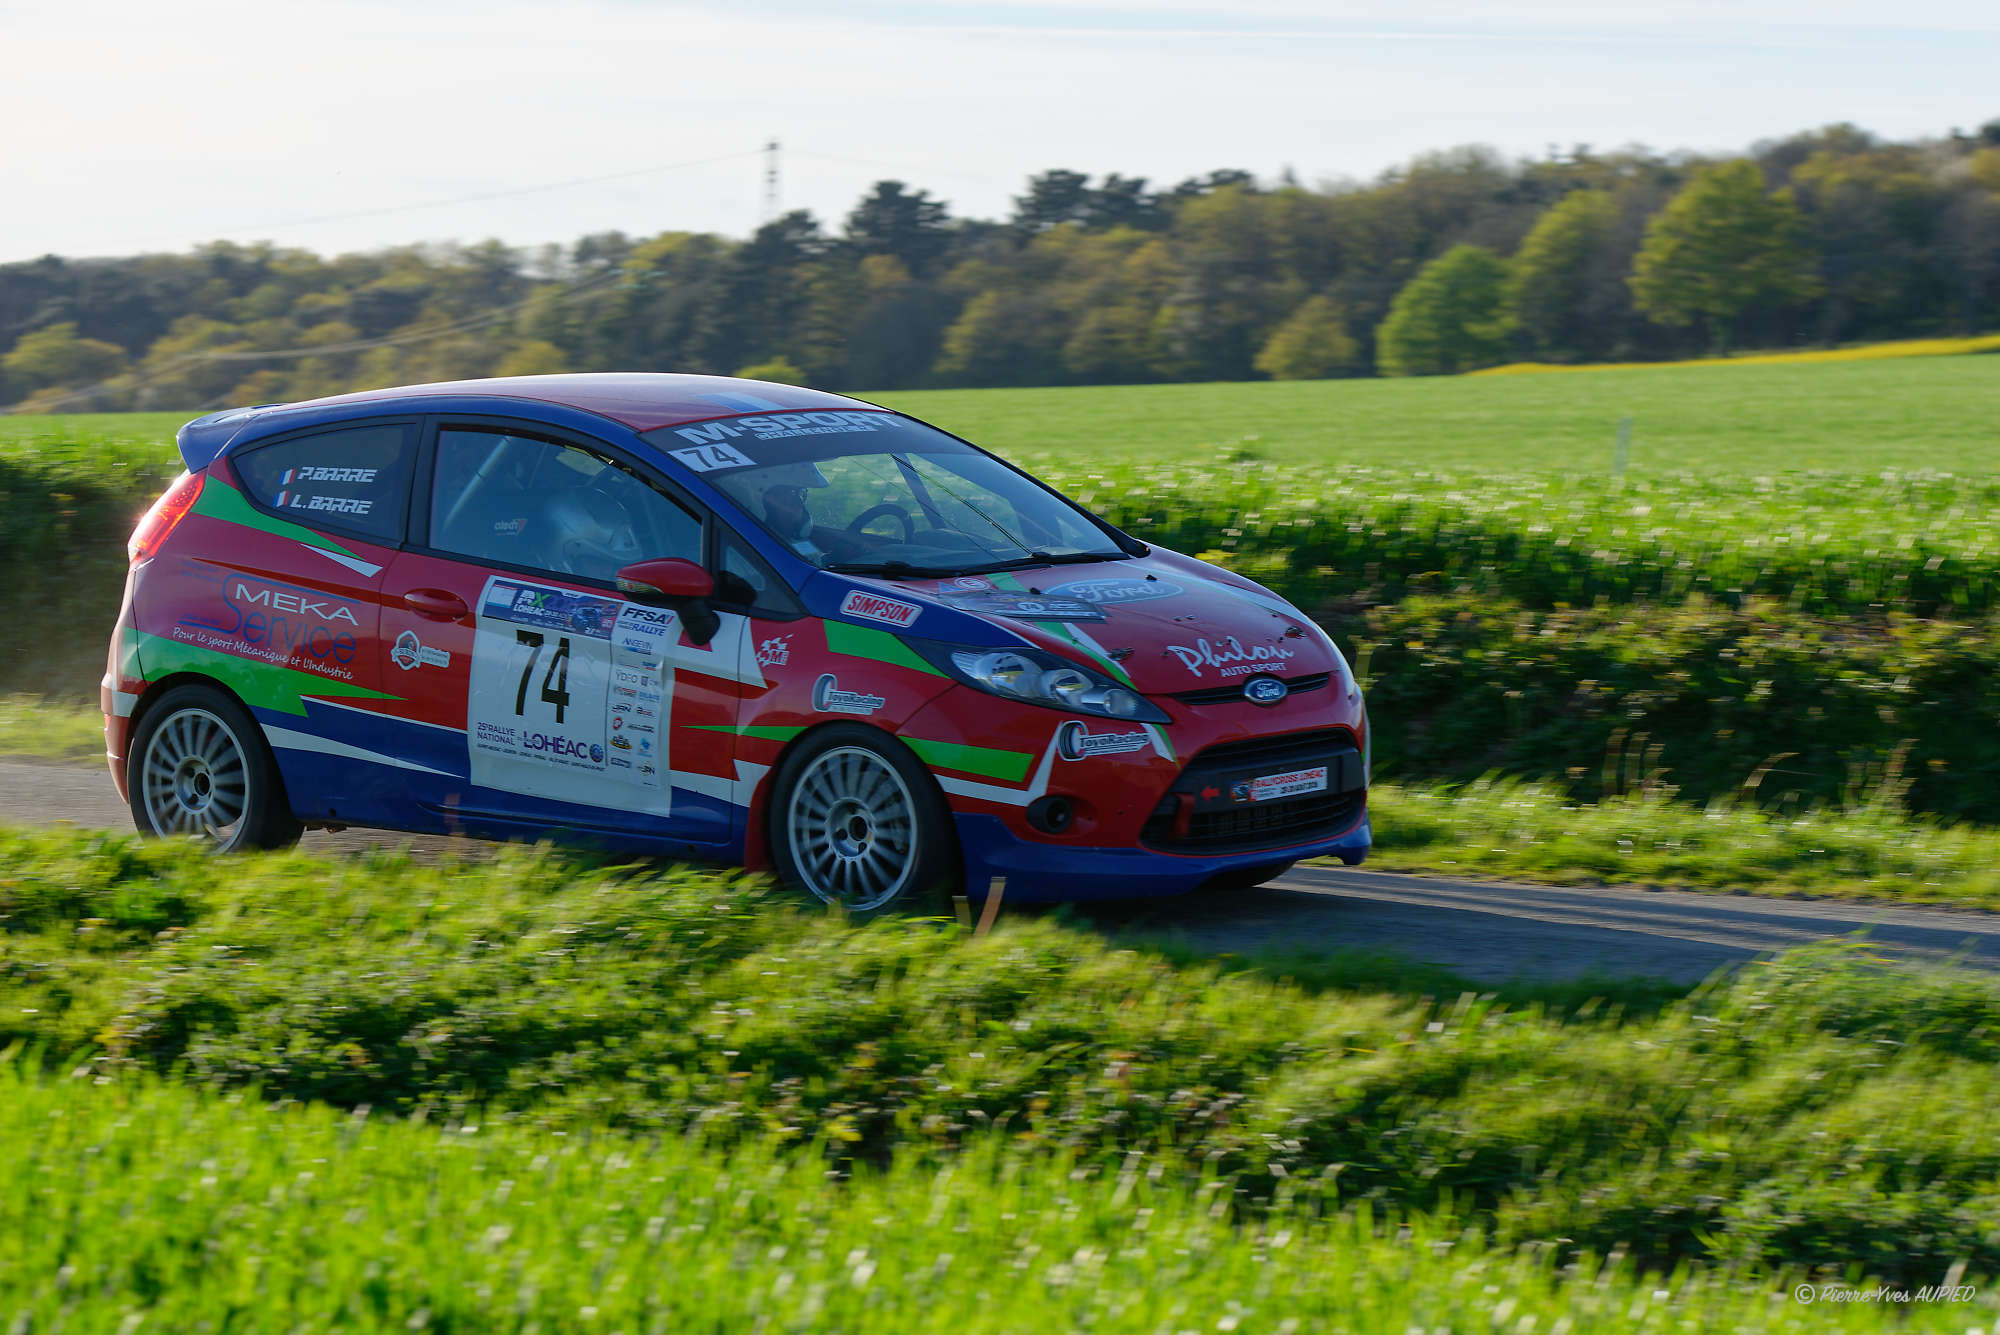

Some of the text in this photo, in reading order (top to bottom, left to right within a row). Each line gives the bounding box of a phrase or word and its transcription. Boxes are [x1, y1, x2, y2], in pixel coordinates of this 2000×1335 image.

[674, 412, 901, 444] M-SPORT
[684, 444, 739, 467] 74
[298, 466, 377, 482] P.BARRE
[1069, 581, 1166, 602] Ford
[235, 583, 359, 626] MEKA
[622, 607, 667, 625] FFSA
[847, 594, 915, 622] SIMPSON
[222, 573, 358, 663] Service
[632, 623, 667, 637] RALLYE
[173, 626, 195, 641] Pour
[207, 634, 233, 650] sport
[290, 655, 301, 666] et
[515, 629, 570, 724] 74
[1220, 662, 1288, 678] AUTO SPORT
[1256, 682, 1281, 697] Ford
[477, 731, 516, 746] NATIONAL
[523, 730, 588, 759] LOHÉAC
